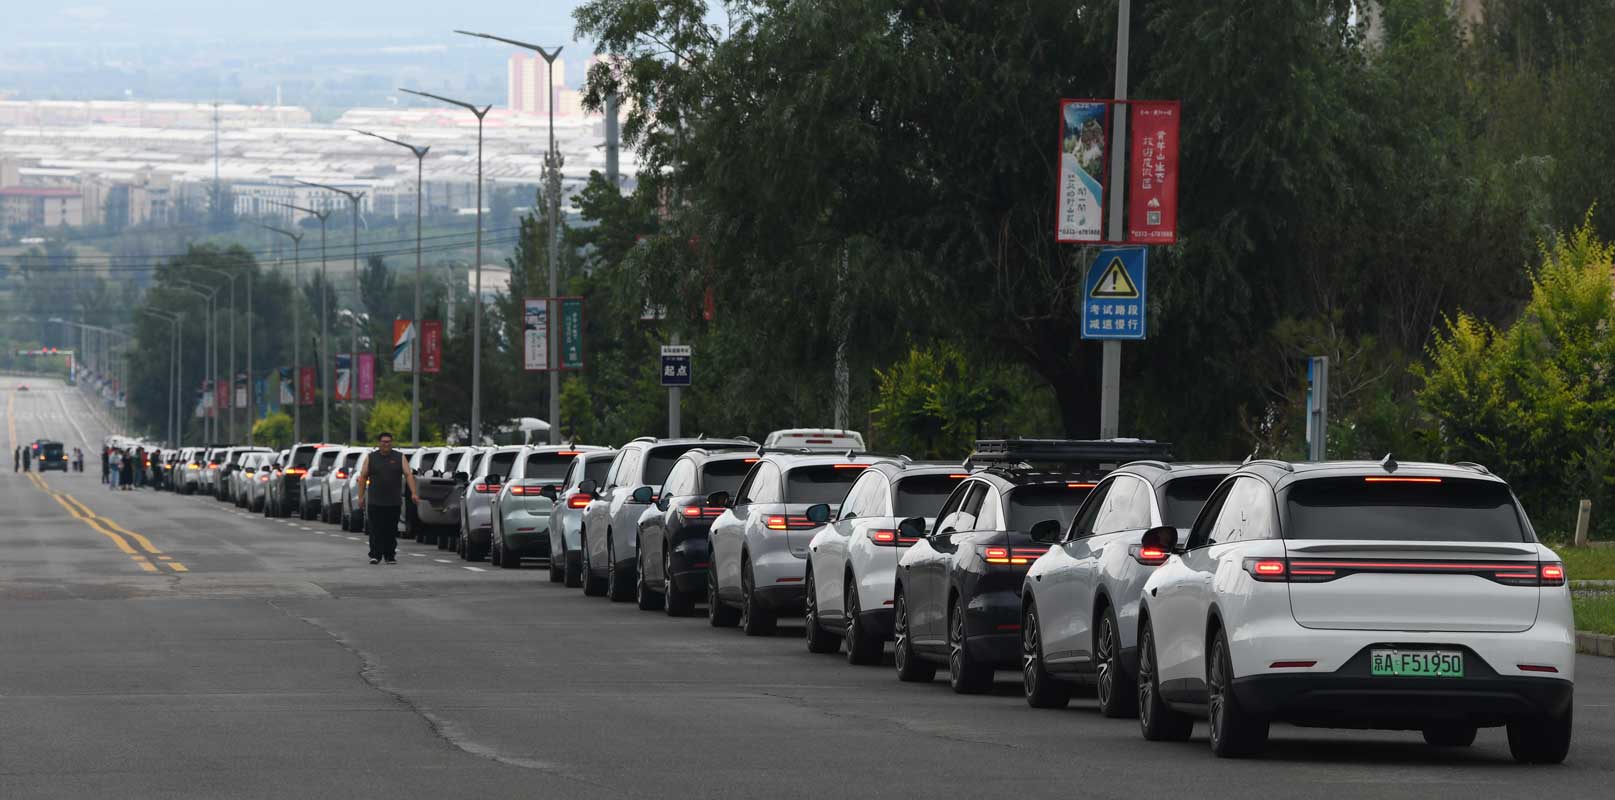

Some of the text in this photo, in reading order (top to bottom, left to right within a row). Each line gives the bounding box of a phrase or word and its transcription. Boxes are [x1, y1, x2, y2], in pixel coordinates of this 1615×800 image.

[1142, 136, 1154, 190] 旅游度假区
[1090, 304, 1138, 316] 考试路段
[1089, 319, 1138, 330] 减速慢行
[664, 365, 688, 376] 起点
[1373, 654, 1461, 673] 京A F51950
